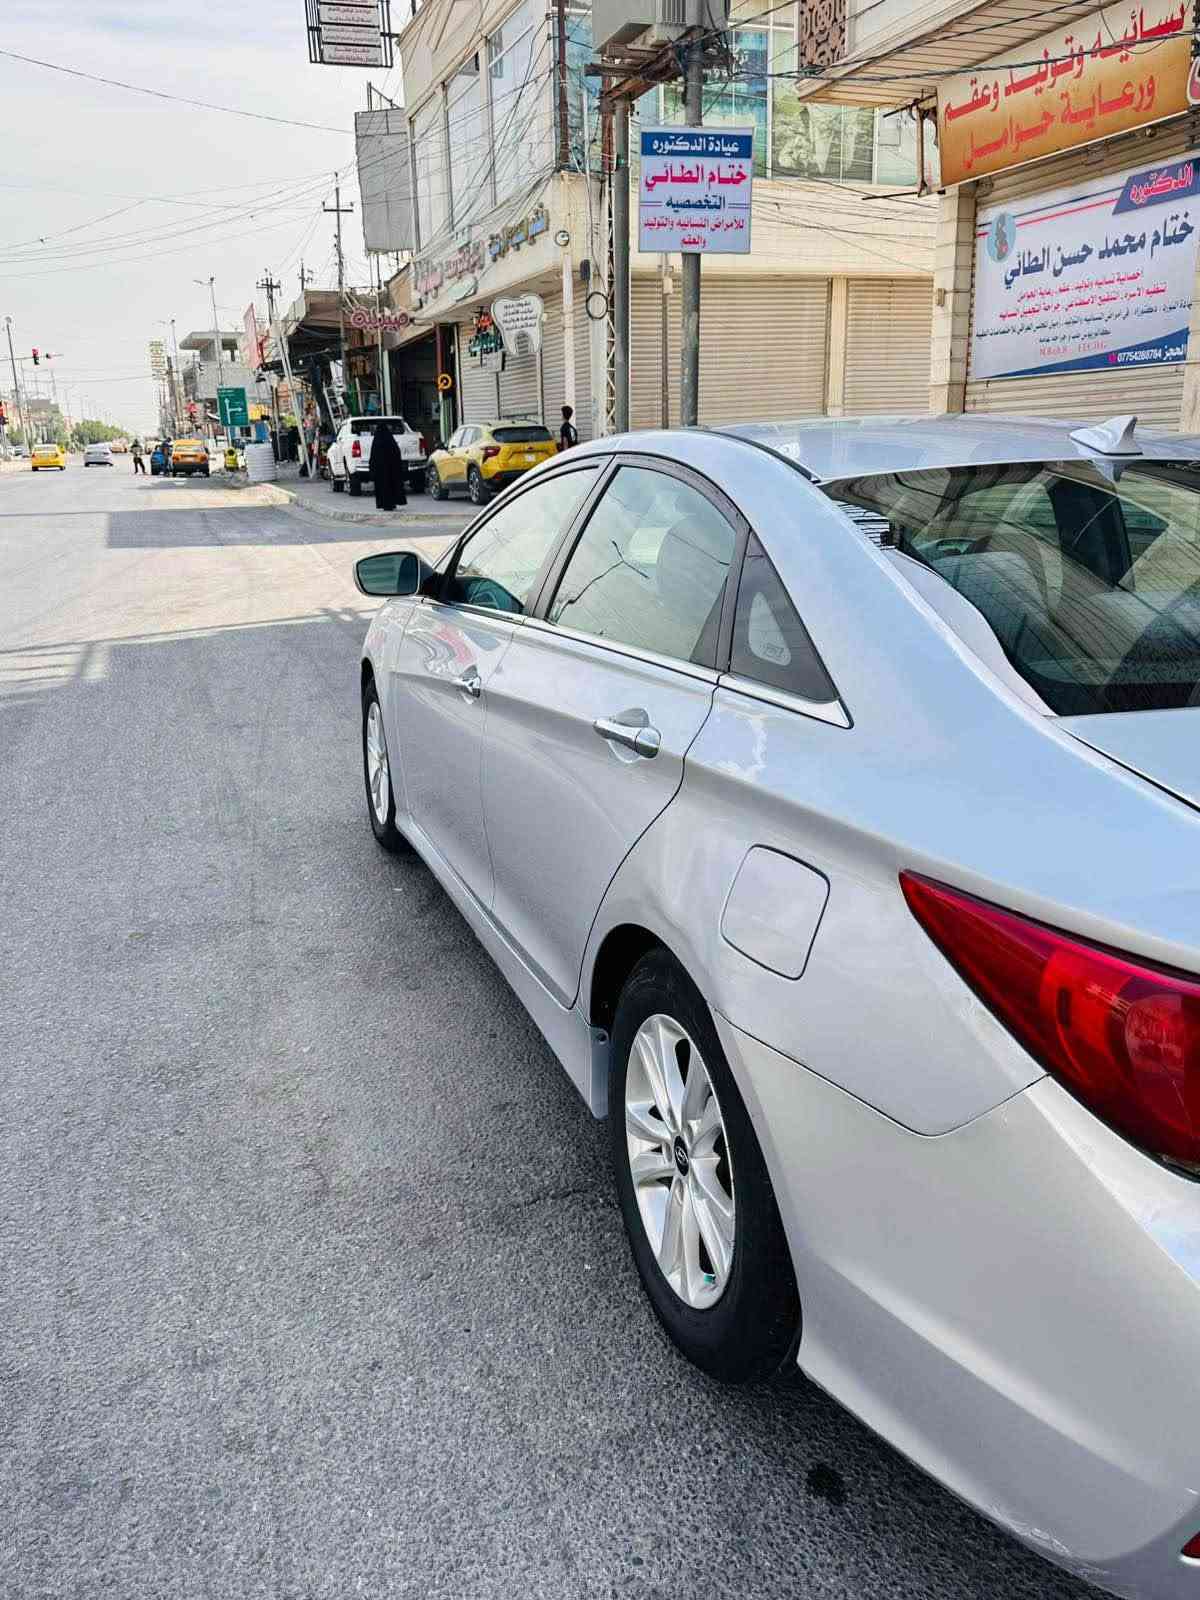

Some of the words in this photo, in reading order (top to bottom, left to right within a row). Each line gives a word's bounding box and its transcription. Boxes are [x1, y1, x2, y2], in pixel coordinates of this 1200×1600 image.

[944, 77, 1000, 129] وعقم
[1060, 75, 1156, 129] ورعاية
[708, 136, 740, 156] عيادة
[963, 111, 1055, 170] حوامل
[645, 162, 704, 191] الطائي
[708, 163, 748, 190] ختام
[1098, 231, 1146, 259] محمد
[1151, 211, 1194, 259] ختام
[1004, 245, 1050, 289] الطائي
[1053, 244, 1094, 277] حسن
